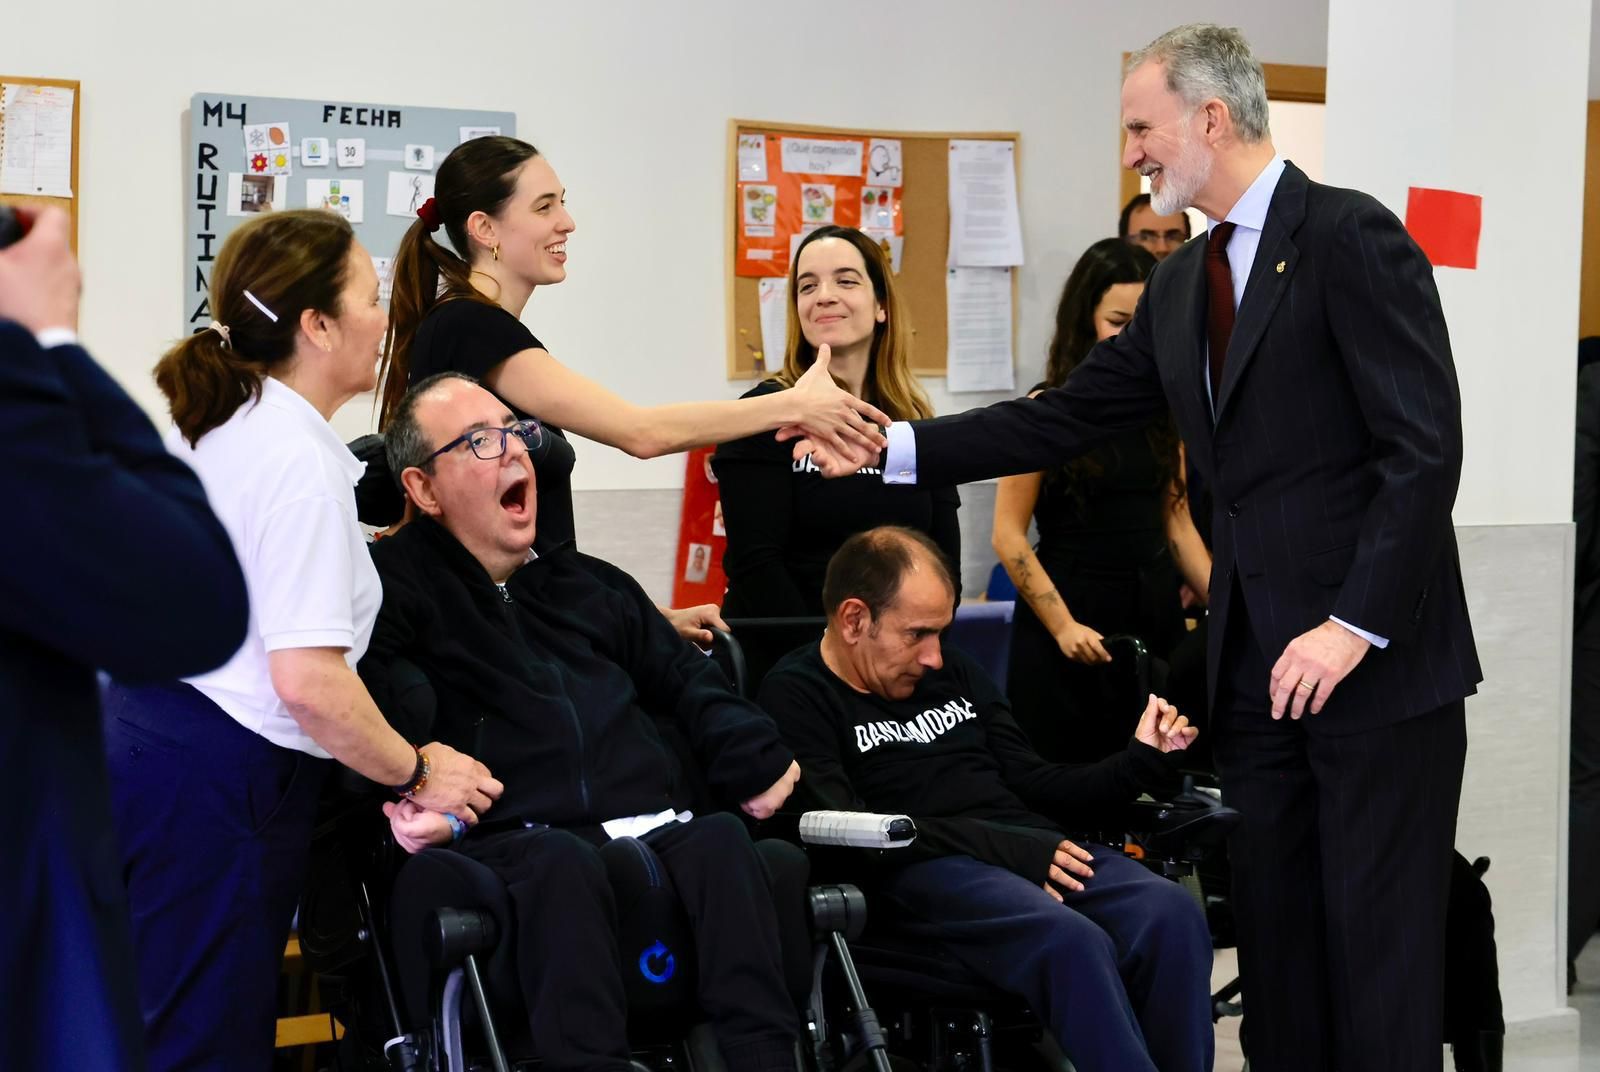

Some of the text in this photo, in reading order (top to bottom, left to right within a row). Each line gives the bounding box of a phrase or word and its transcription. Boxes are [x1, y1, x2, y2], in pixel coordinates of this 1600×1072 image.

[323, 105, 401, 128] FECHA
[344, 146, 357, 157] 30
[190, 143, 218, 333] RUTINA
